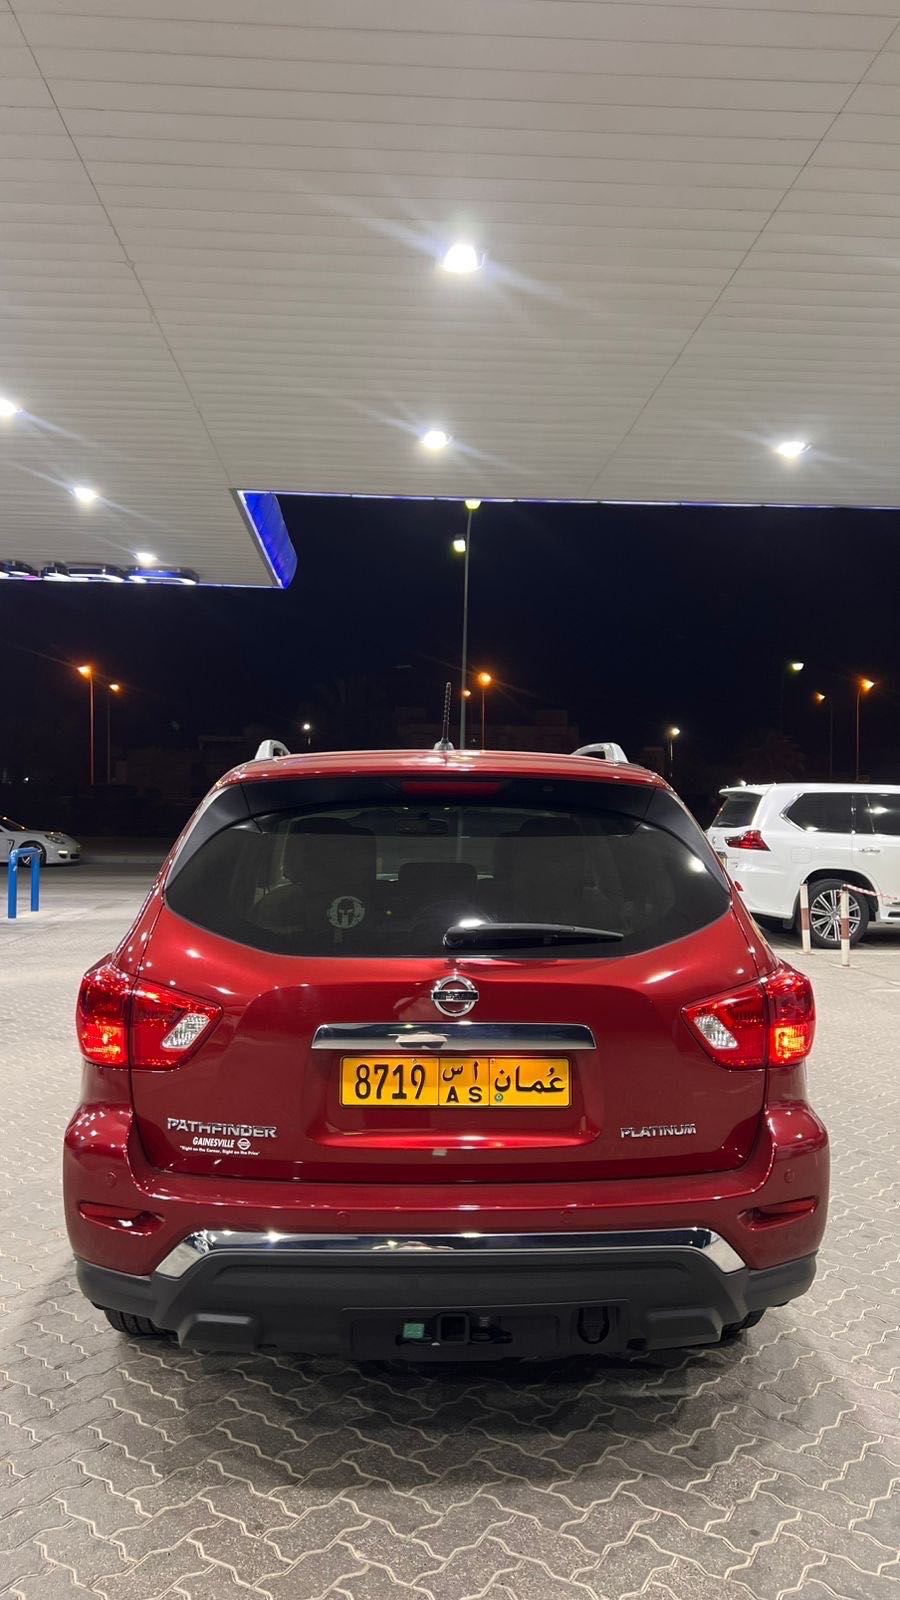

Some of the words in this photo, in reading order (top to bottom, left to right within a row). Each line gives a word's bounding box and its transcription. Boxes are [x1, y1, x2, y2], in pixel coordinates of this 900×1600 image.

[355, 1064, 426, 1100] 8719
[167, 1117, 278, 1138] PATHFINDER
[620, 1123, 697, 1139] PLATINUM
[193, 1137, 235, 1148] GAINESVILLE
